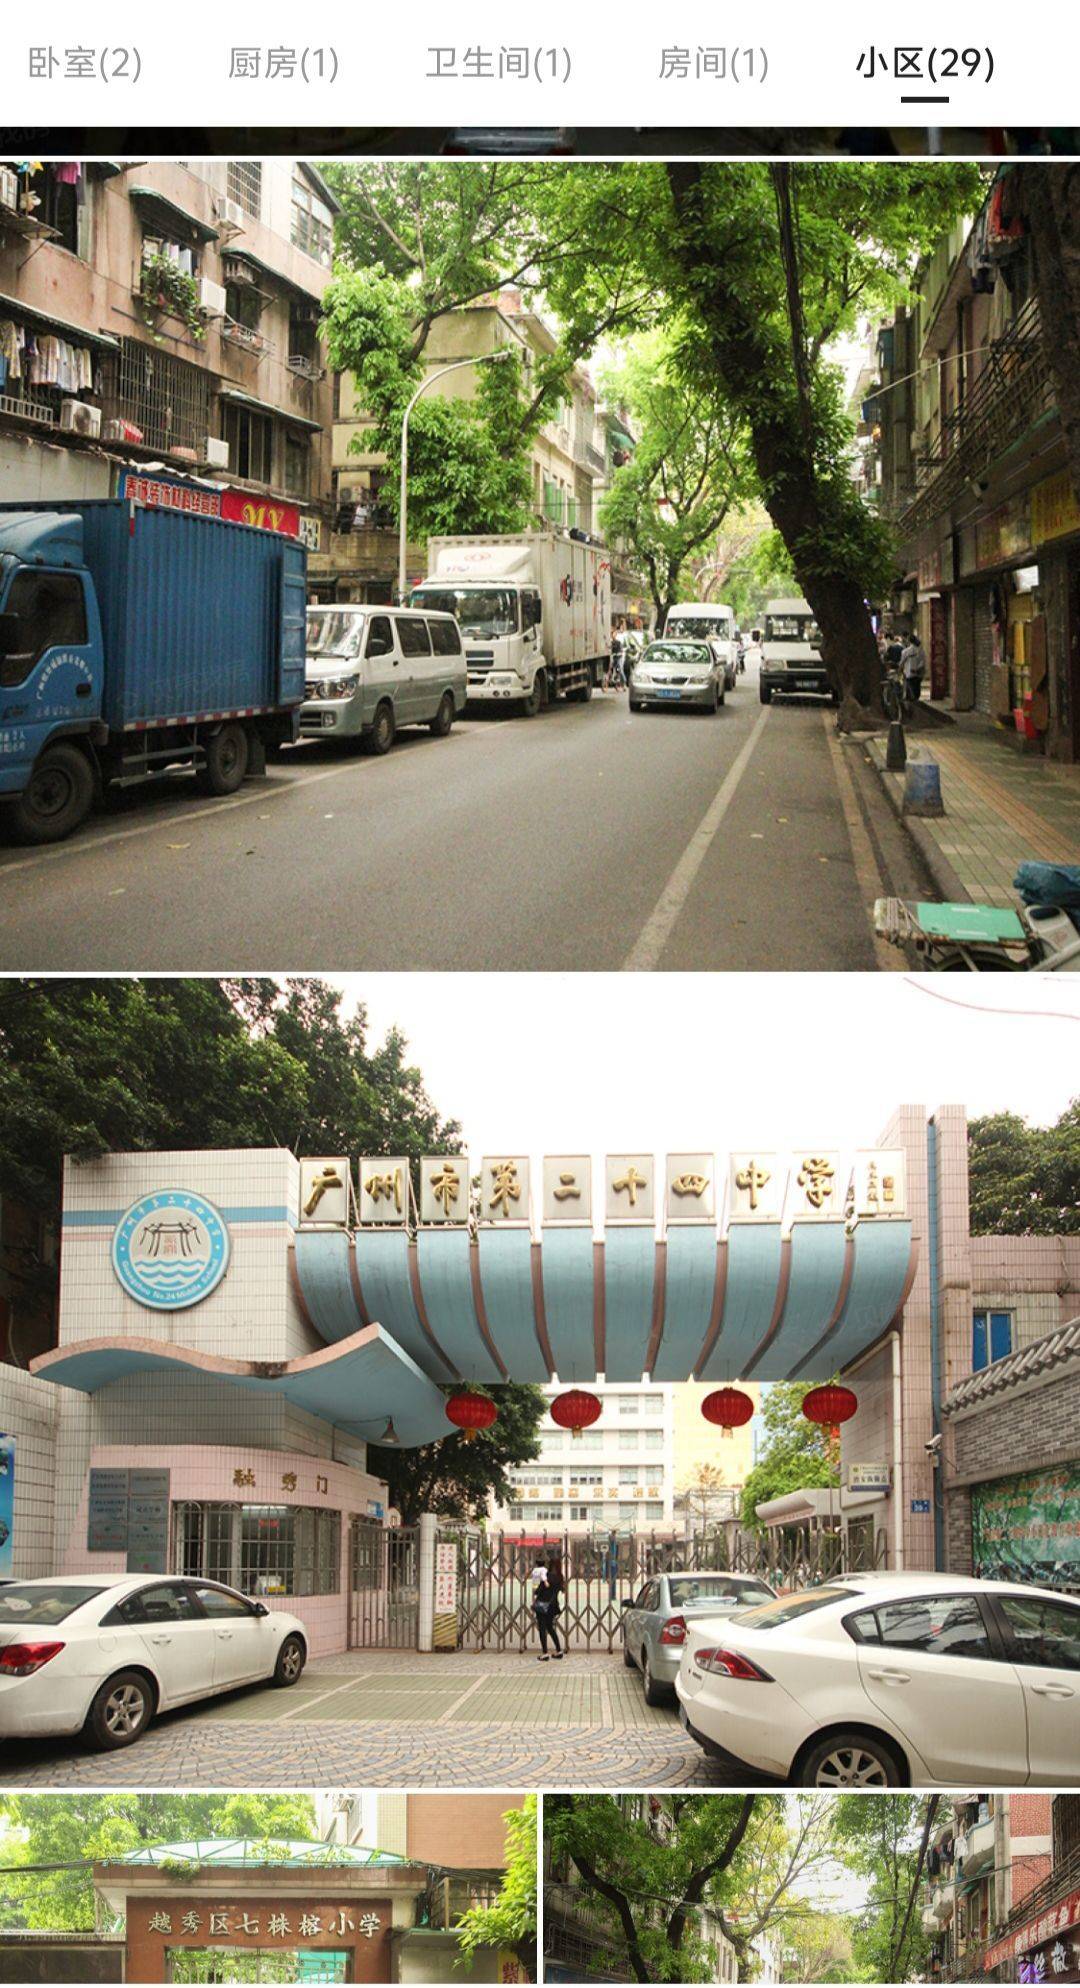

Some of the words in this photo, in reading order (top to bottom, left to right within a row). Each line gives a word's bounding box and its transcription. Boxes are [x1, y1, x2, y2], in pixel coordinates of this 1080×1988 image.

[30, 46, 141, 83] 卧室(2)
[229, 46, 338, 83] 厨房(1)
[426, 46, 571, 83] 卫生间(1)
[659, 46, 768, 83] 房间(1)
[856, 46, 994, 83] 小区(29)
[303, 1157, 835, 1216] 广州市第二十四中学
[148, 1911, 383, 1940] 越秀区七株榕小学
